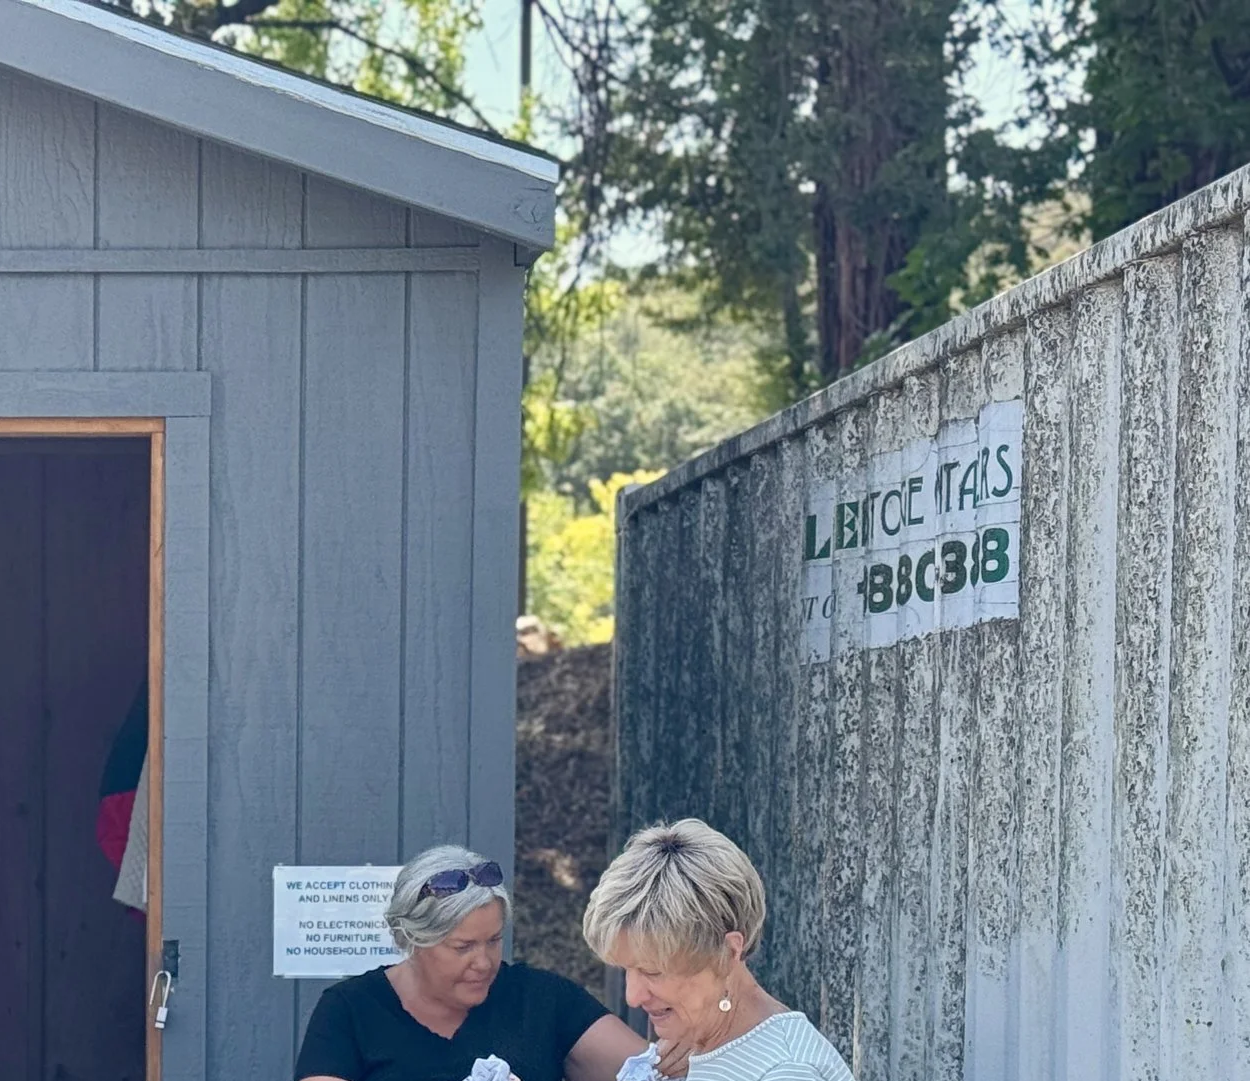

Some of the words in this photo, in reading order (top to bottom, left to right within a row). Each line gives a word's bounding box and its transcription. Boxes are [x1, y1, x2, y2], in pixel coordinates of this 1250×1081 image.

[286, 881, 303, 890] WE
[305, 881, 346, 890] ACCEPT
[299, 894, 320, 903] AND
[323, 894, 359, 903] LINENS
[362, 894, 388, 903] ONLY
[299, 921, 314, 929] NO
[317, 920, 388, 929] ELECTRONICS
[306, 934, 321, 942] NO
[323, 933, 381, 942] FURNITURE
[286, 947, 301, 955] NO
[304, 947, 367, 955] HOUSEHOLD
